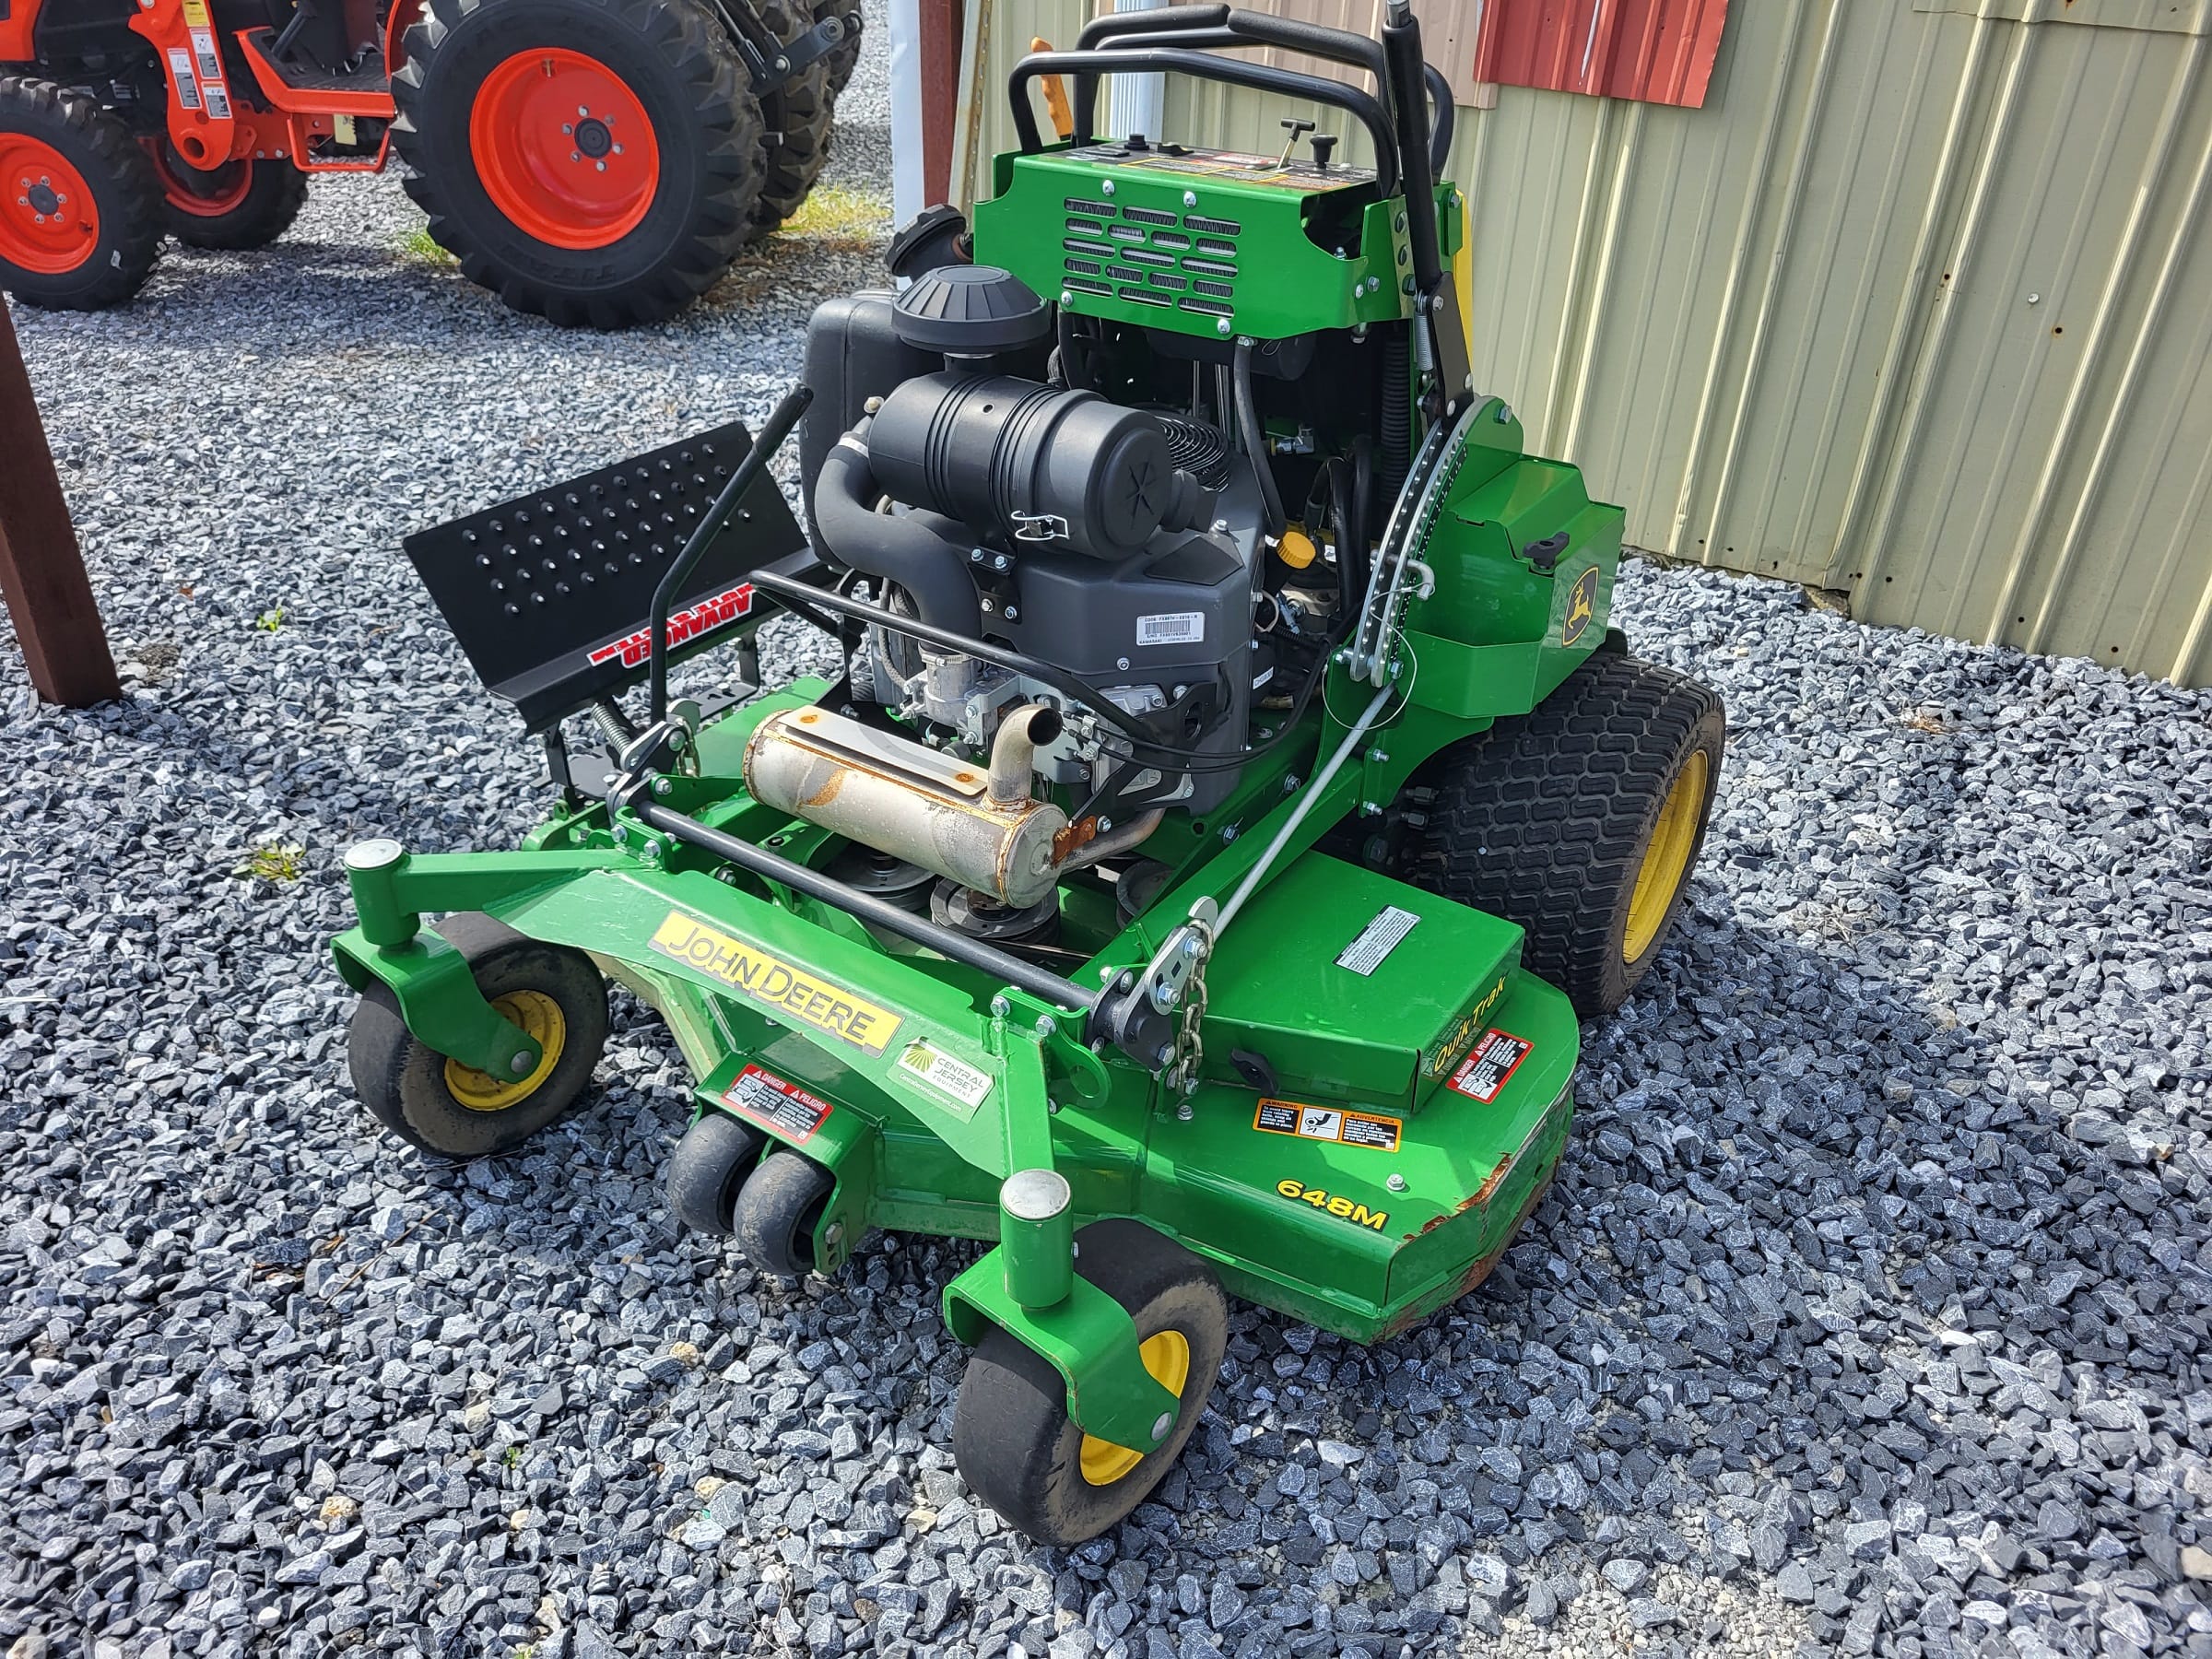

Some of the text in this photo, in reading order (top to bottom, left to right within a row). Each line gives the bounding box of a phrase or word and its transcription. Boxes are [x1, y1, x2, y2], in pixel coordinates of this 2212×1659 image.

[669, 927, 877, 1041] JOHN DEERE
[761, 1073, 787, 1090] DANGER
[935, 1068, 978, 1093] JERSEY
[937, 1057, 984, 1088] CENTRAL
[1458, 1059, 1475, 1081] DANGER
[933, 1075, 971, 1099] EQUIPMENT
[799, 1092, 827, 1112] PELIGRO
[1272, 1100, 1298, 1109] WARNING
[1277, 1179, 1387, 1230] 648M
